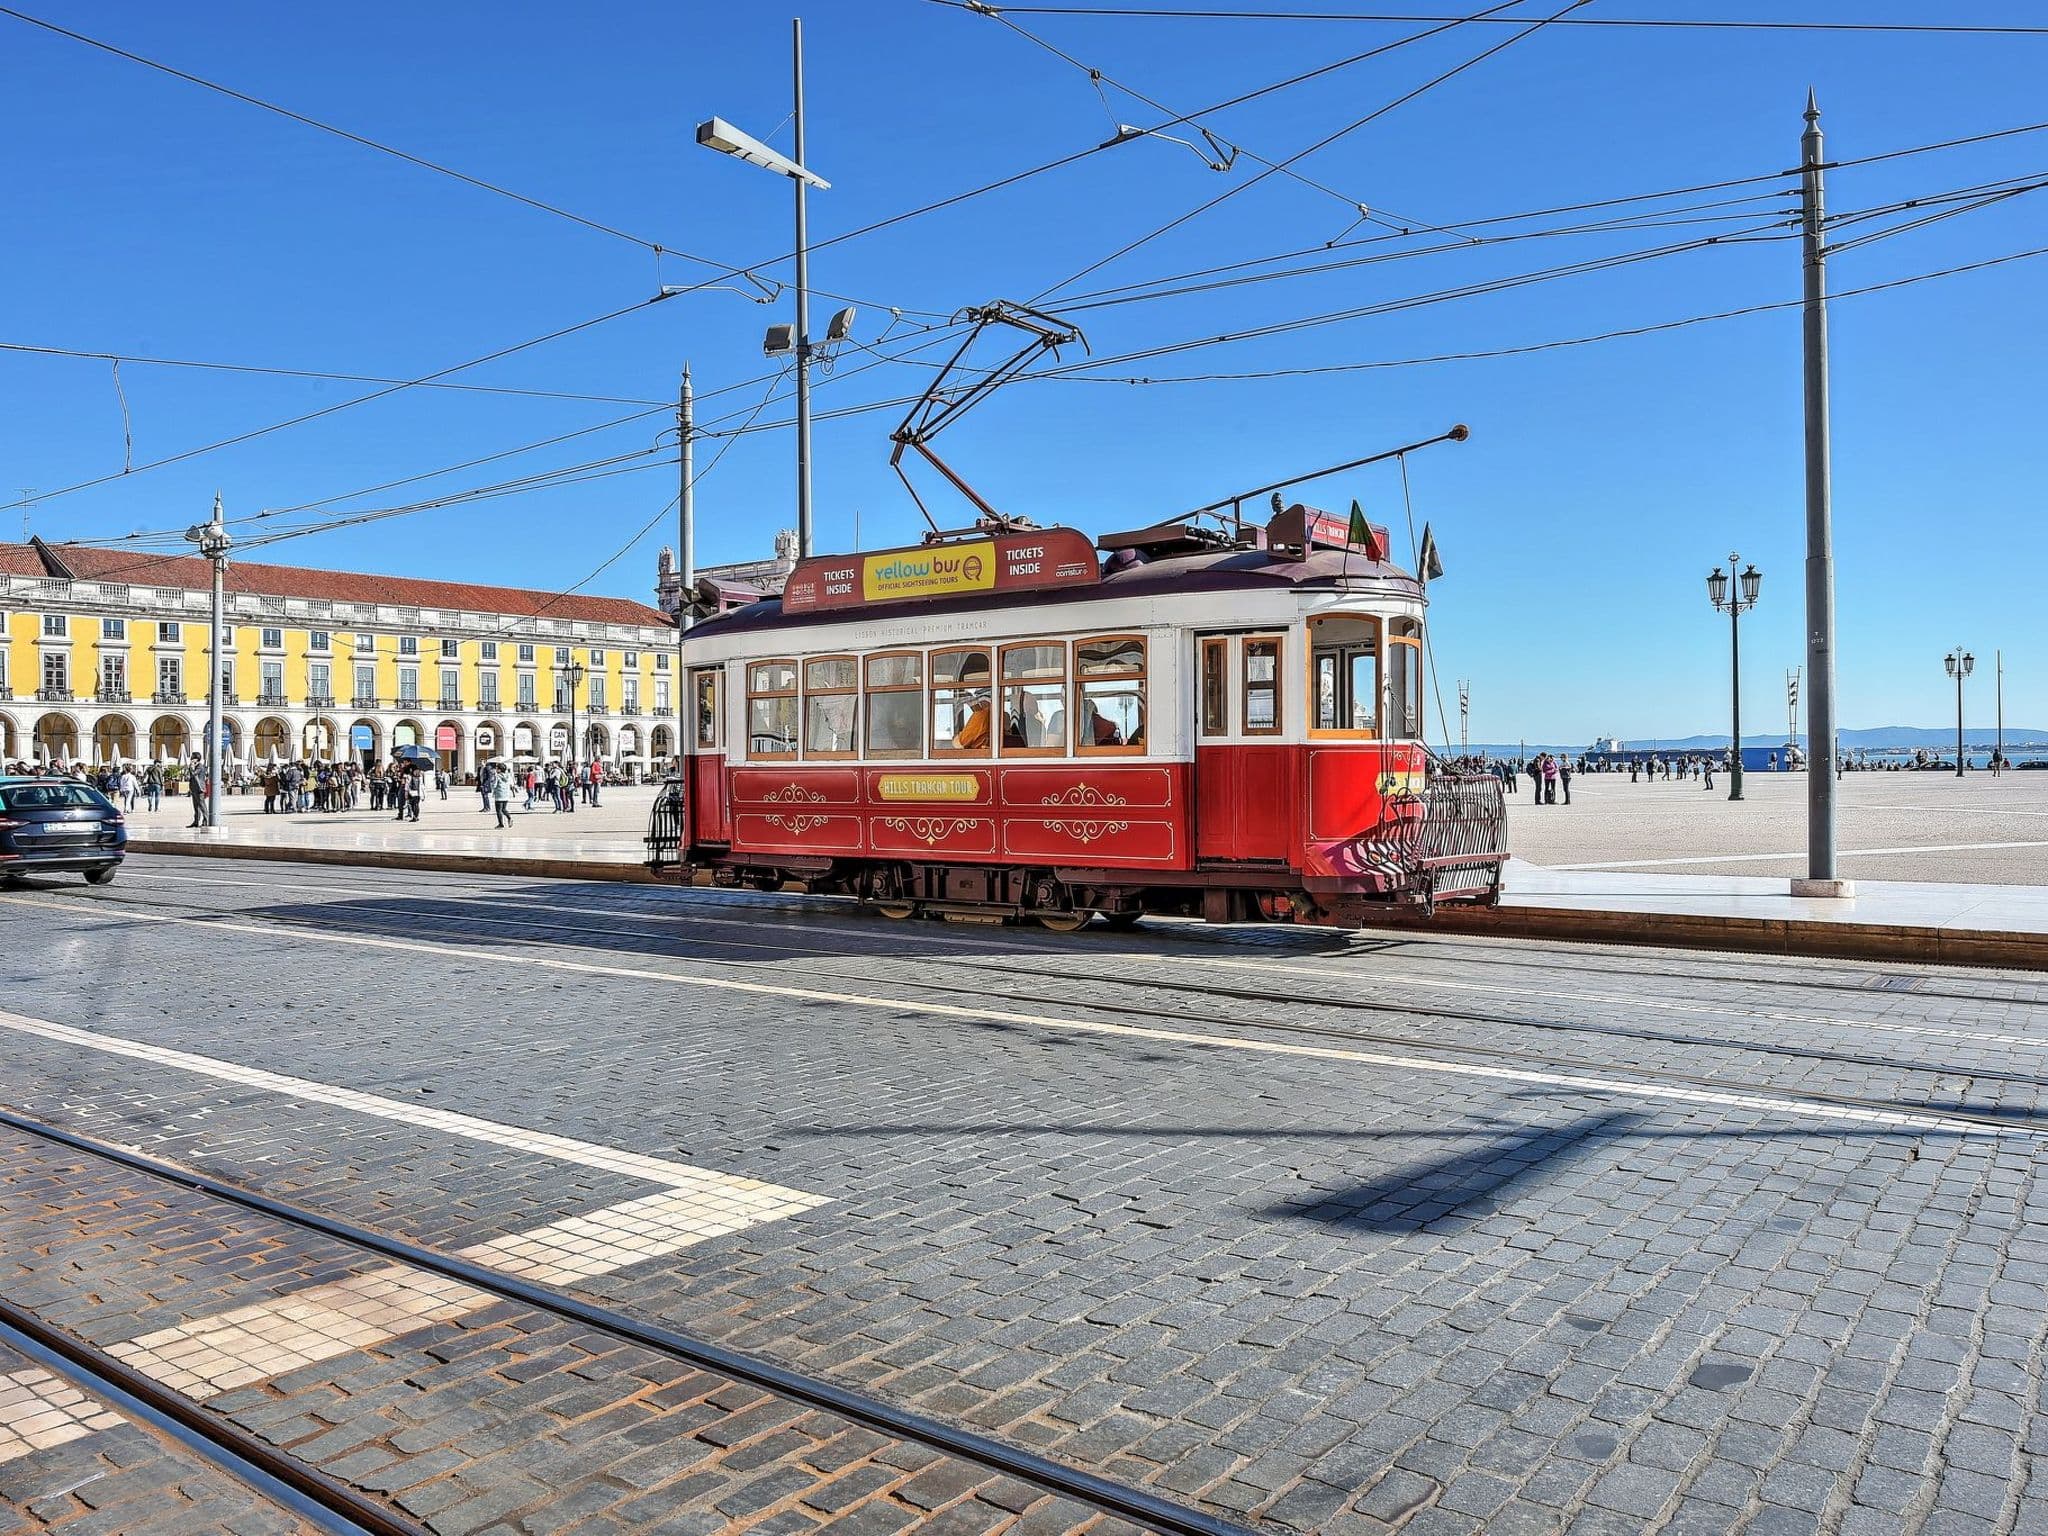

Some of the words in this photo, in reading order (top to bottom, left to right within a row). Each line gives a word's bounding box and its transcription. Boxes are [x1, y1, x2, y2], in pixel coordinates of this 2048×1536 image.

[1006, 546, 1044, 561] TICKETS
[823, 569, 855, 582] TICKETS
[875, 559, 930, 580] yellow
[933, 556, 960, 574] bus
[1009, 562, 1041, 576] INSIDE
[826, 583, 852, 596] INSIDE
[877, 581, 901, 591] OFFICIAL
[939, 576, 958, 585] TOURS
[884, 781, 909, 794] HILLS
[950, 780, 973, 795] TOUR
